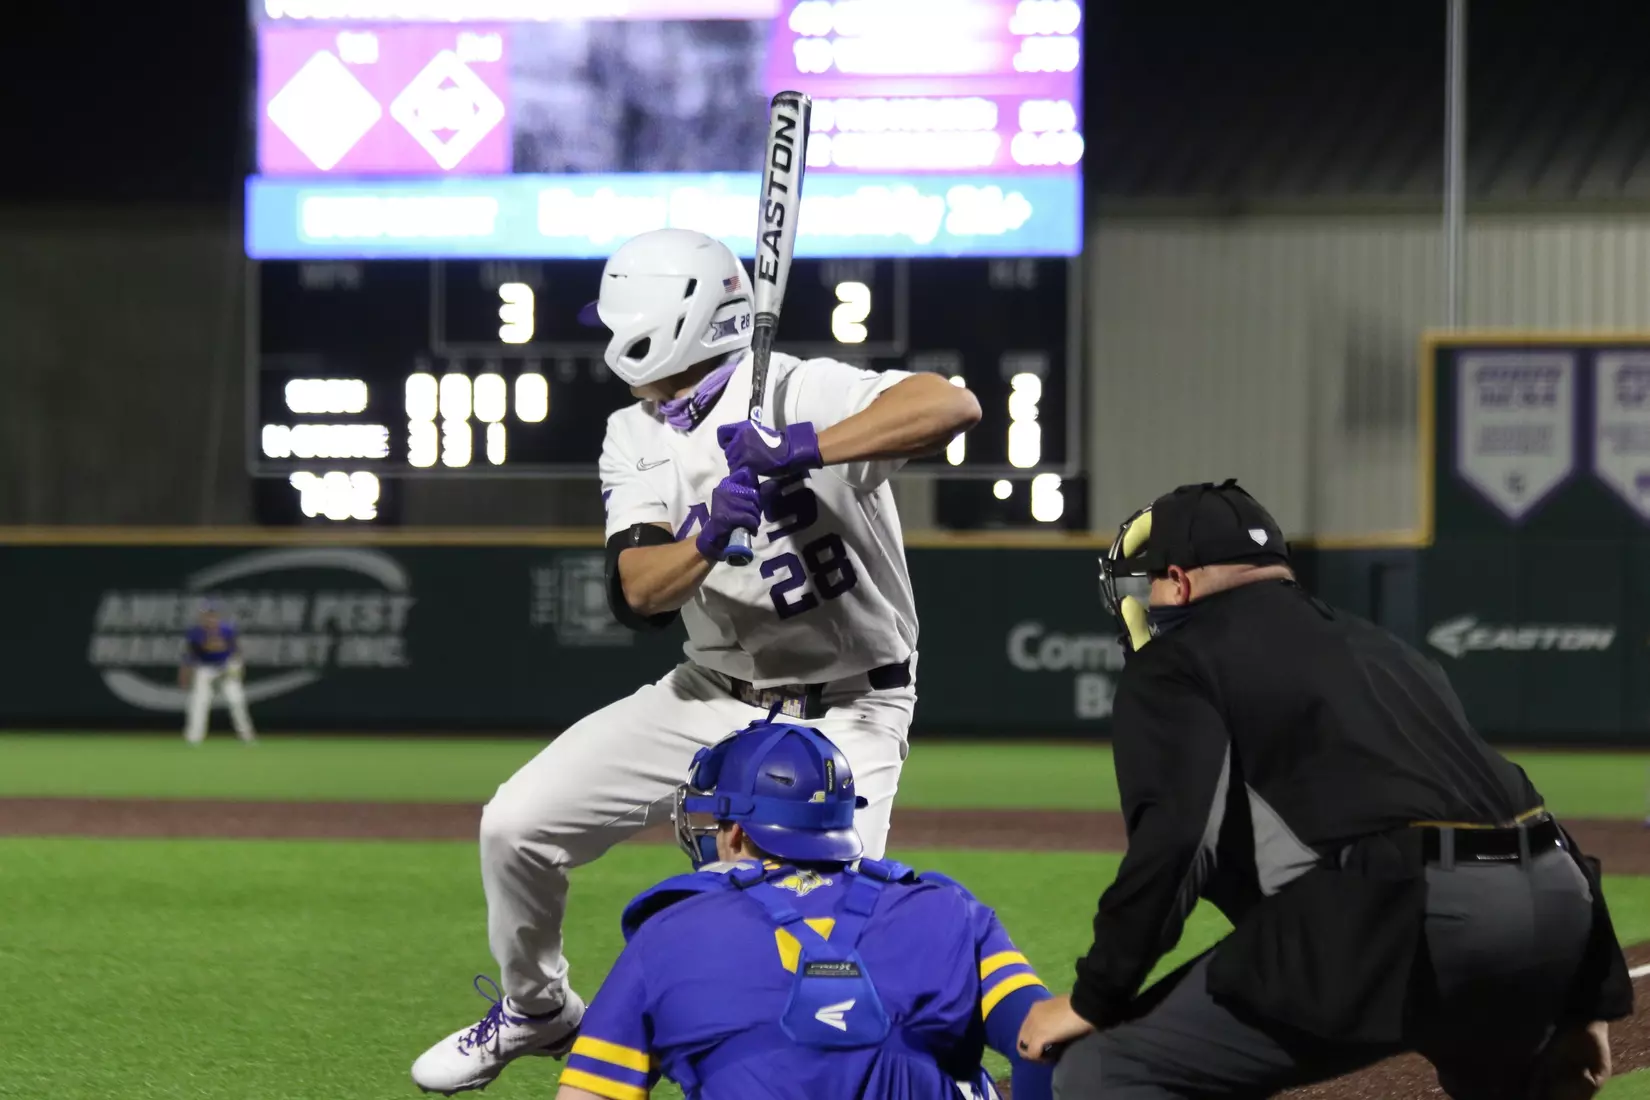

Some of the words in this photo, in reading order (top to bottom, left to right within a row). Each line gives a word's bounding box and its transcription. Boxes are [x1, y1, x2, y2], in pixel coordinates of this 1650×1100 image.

[758, 113, 797, 286] EASTON
[498, 282, 535, 344] 3
[740, 313, 751, 330] 28
[831, 281, 871, 343] 2
[759, 532, 858, 621] 28
